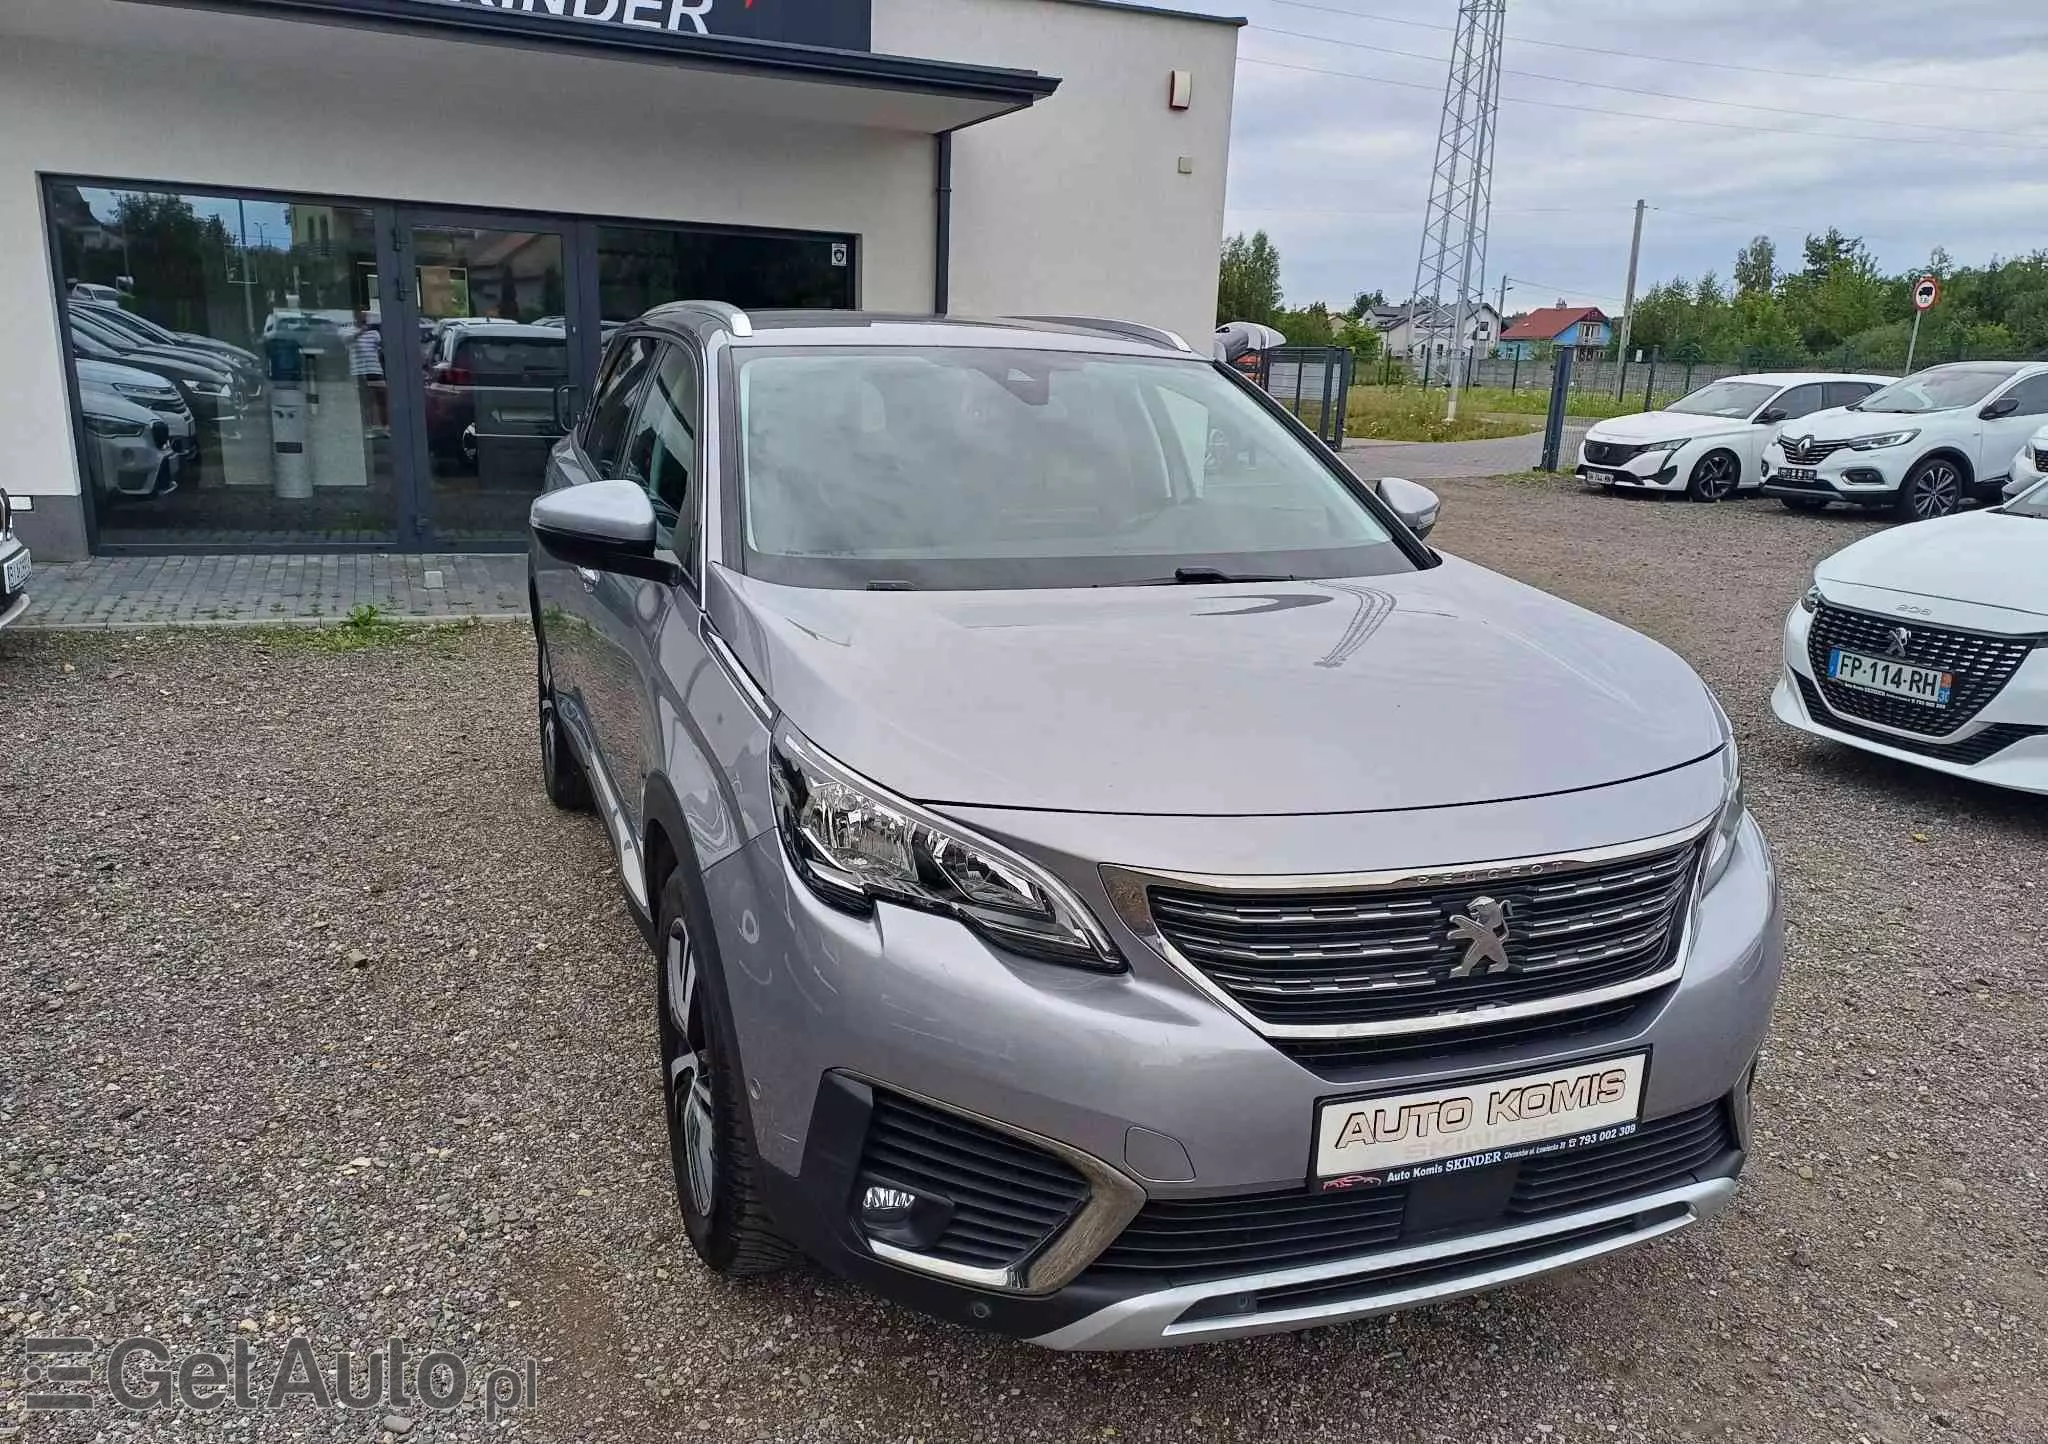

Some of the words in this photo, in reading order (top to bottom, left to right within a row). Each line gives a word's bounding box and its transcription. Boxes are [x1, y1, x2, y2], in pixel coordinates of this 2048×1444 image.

[1334, 1096, 1474, 1150] AUTO
[1487, 1068, 1628, 1126] KOMIS
[1386, 1170, 1411, 1183] Auto
[1412, 1164, 1444, 1178] Komis
[1445, 1151, 1502, 1173] SKINDER
[1578, 1133, 1597, 1147] 793
[1599, 1128, 1617, 1142] 002
[1618, 1123, 1637, 1137] 309
